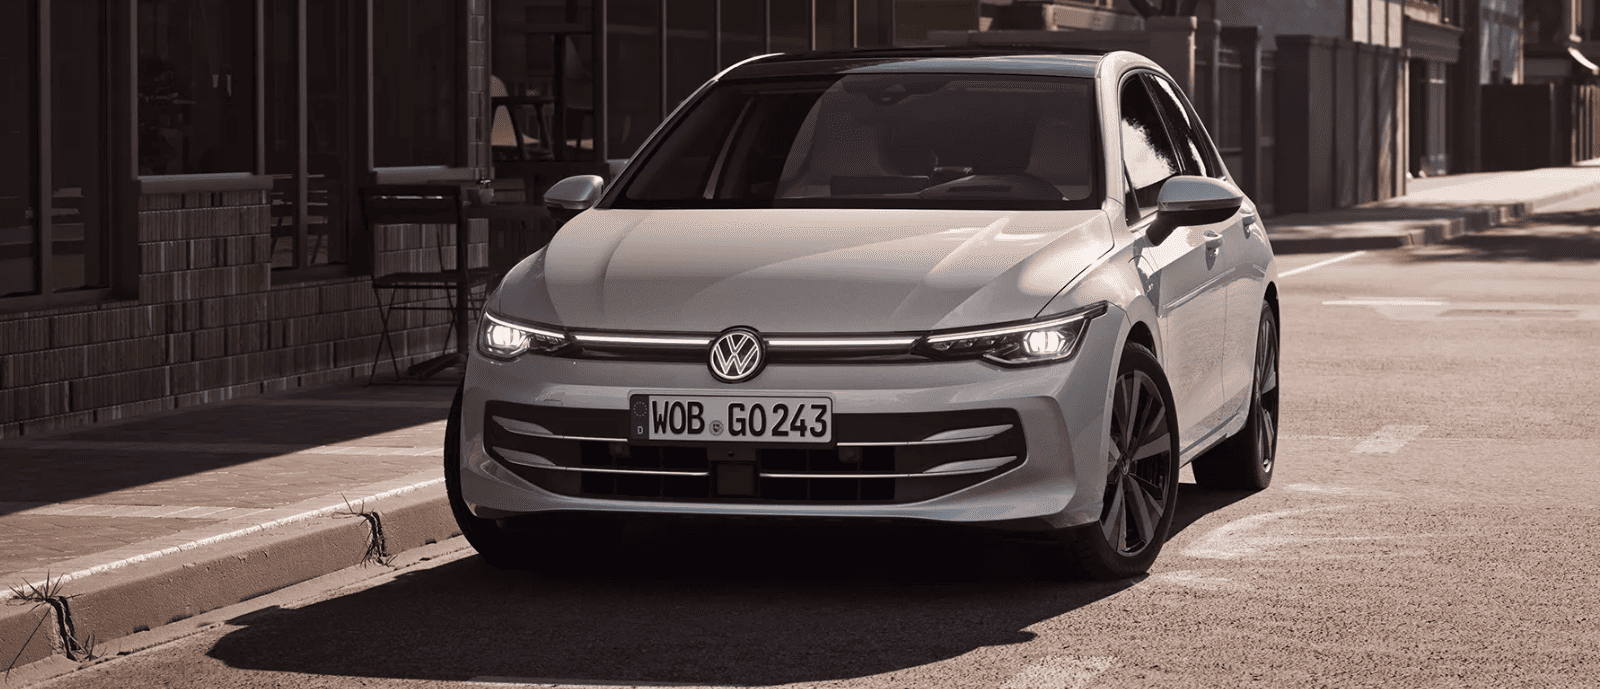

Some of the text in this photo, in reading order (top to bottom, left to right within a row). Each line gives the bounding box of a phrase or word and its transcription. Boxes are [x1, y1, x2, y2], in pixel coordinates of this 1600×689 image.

[711, 333, 760, 378] VW
[637, 425, 644, 435] D
[652, 400, 705, 435] WOB
